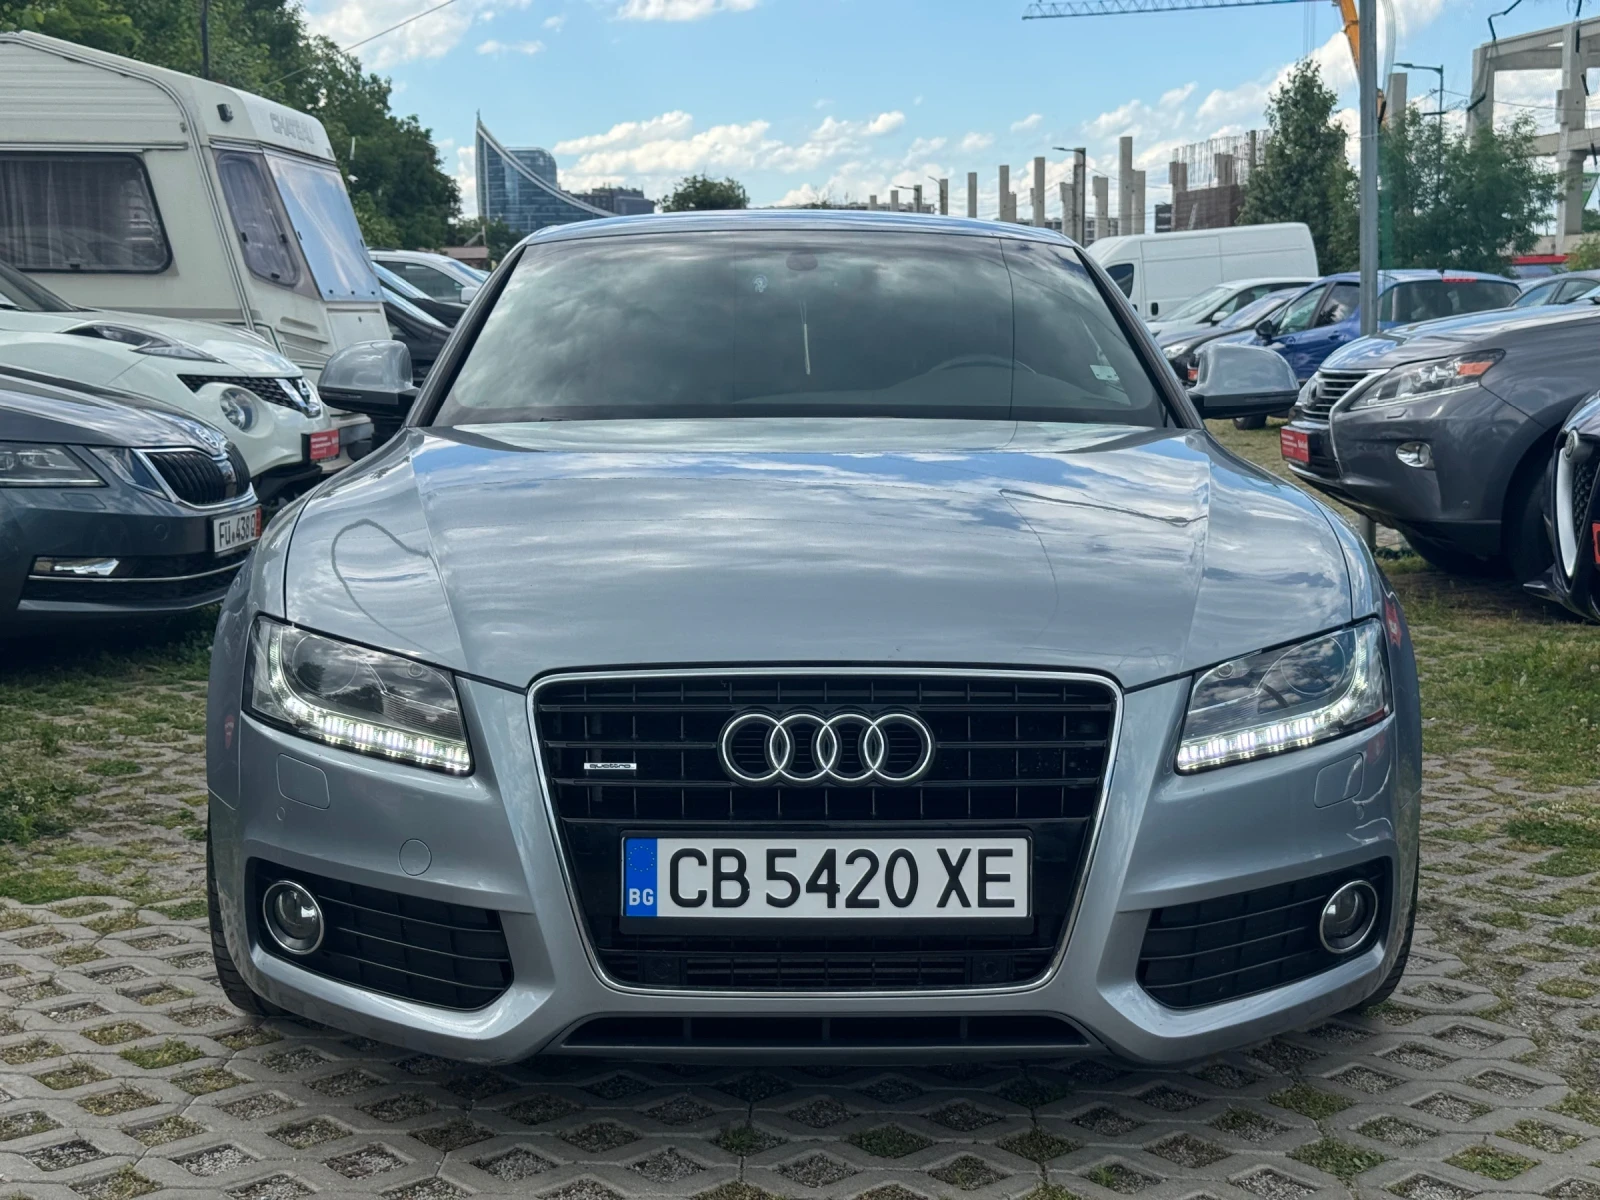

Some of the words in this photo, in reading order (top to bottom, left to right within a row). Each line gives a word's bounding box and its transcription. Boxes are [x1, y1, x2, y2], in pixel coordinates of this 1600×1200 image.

[629, 888, 654, 906] BG
[669, 848, 750, 908] CB
[766, 848, 919, 909] 5420
[936, 848, 1015, 908] XE
